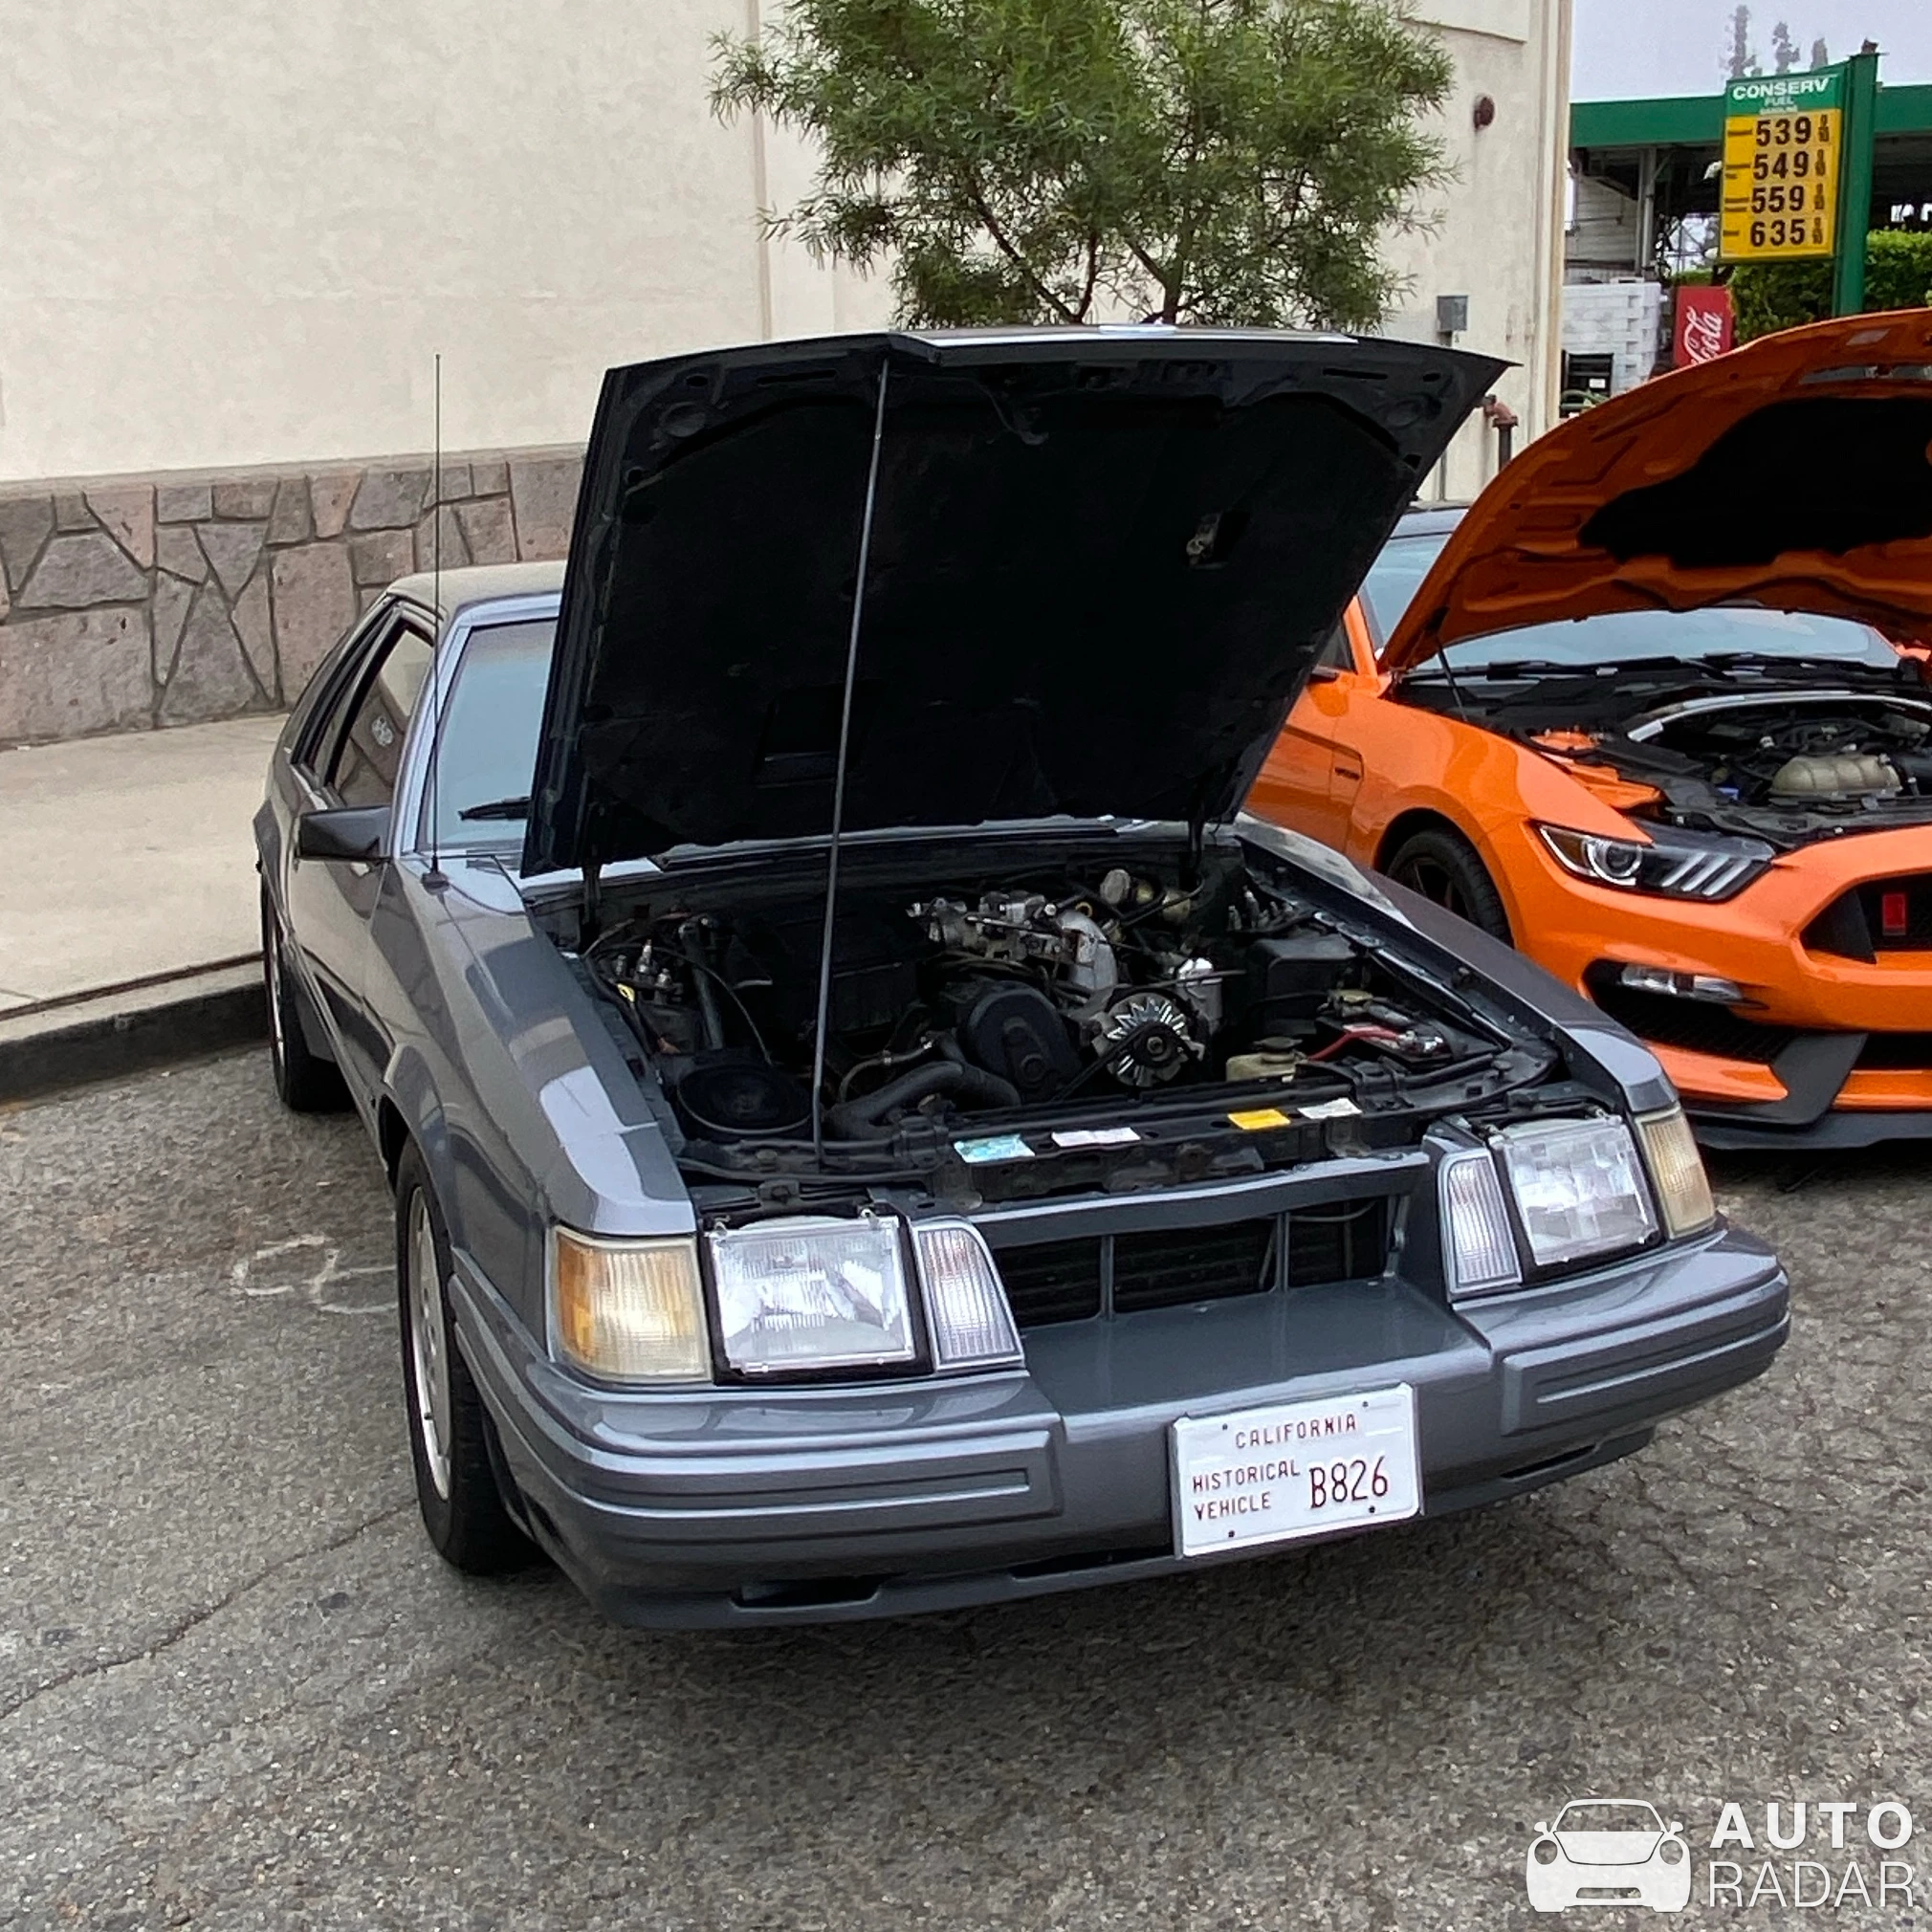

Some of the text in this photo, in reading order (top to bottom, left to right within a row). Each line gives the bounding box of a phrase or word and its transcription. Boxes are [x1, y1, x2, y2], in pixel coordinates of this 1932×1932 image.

[1732, 77, 1829, 100] CONSERV
[1765, 96, 1794, 106] FUEL
[1756, 117, 1811, 146] 539
[1753, 151, 1809, 180] 549
[1751, 186, 1805, 214] 559
[1750, 219, 1806, 247] 635
[1236, 1414, 1356, 1449] CALIFORNIA
[1193, 1460, 1301, 1494] HISTORICAL
[1309, 1456, 1388, 1509] B826
[1194, 1491, 1272, 1521] VEHICLE
